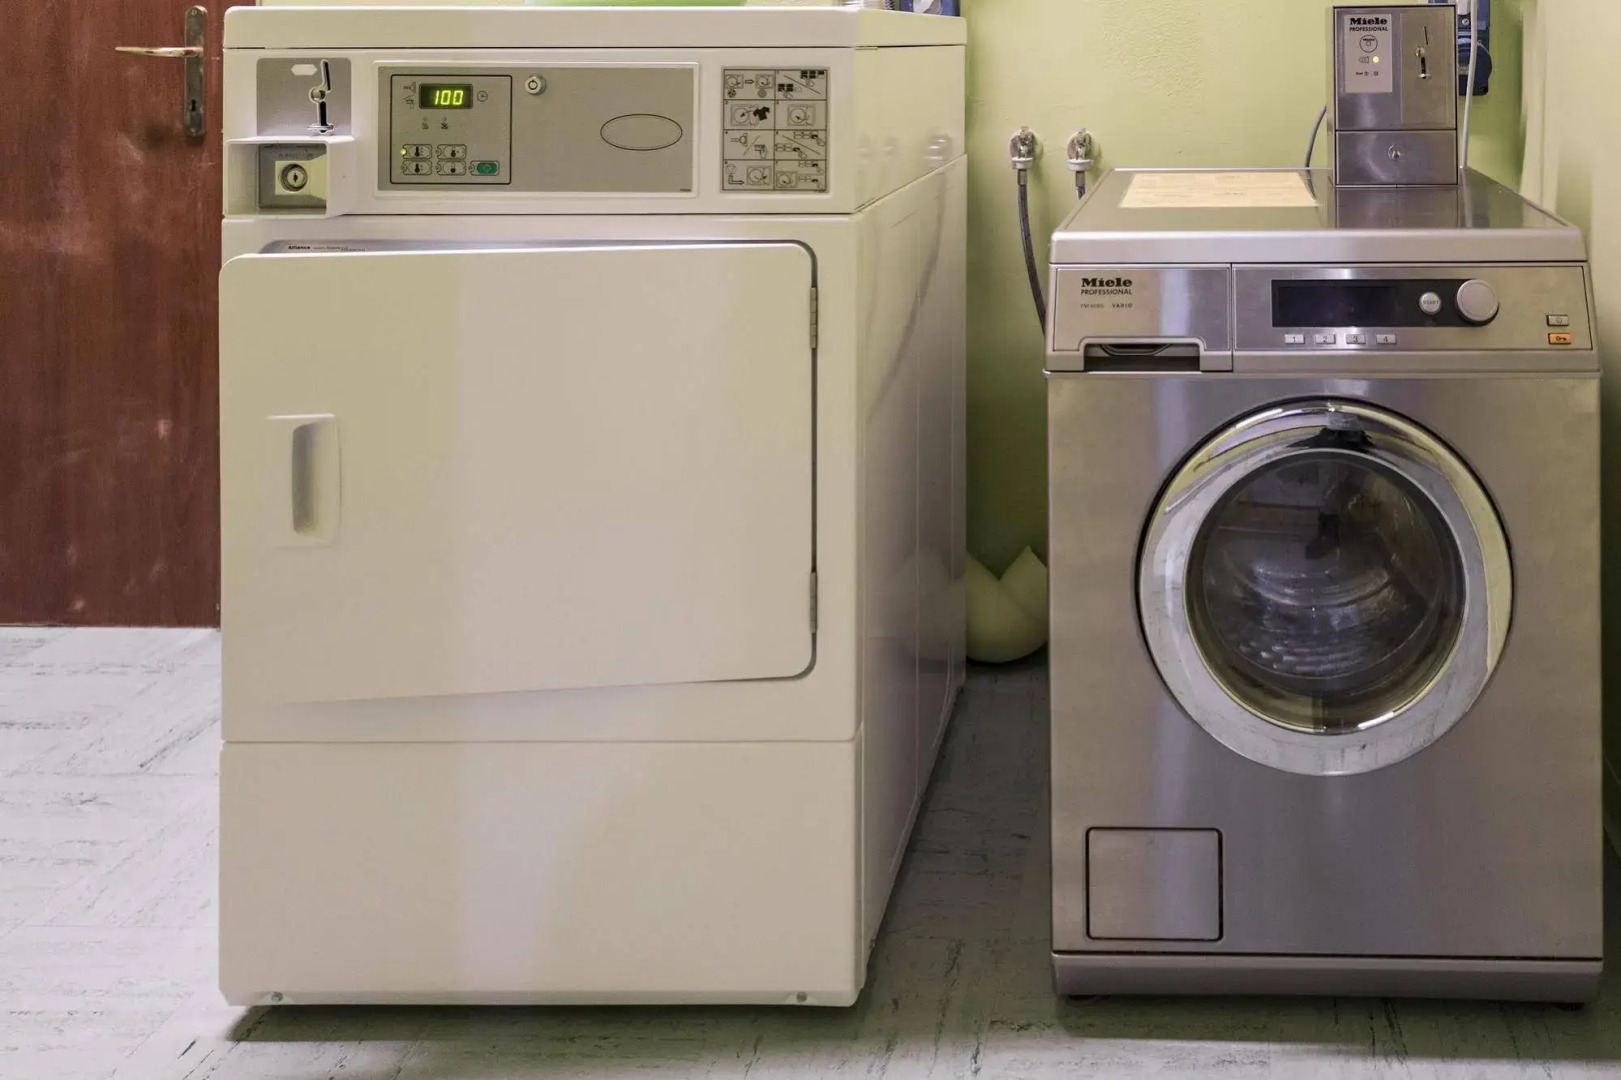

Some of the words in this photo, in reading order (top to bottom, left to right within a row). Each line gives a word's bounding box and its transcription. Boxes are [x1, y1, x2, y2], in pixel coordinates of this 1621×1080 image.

[1349, 17, 1388, 25] Miele
[434, 90, 464, 105] 100
[1081, 277, 1133, 287] Miele
